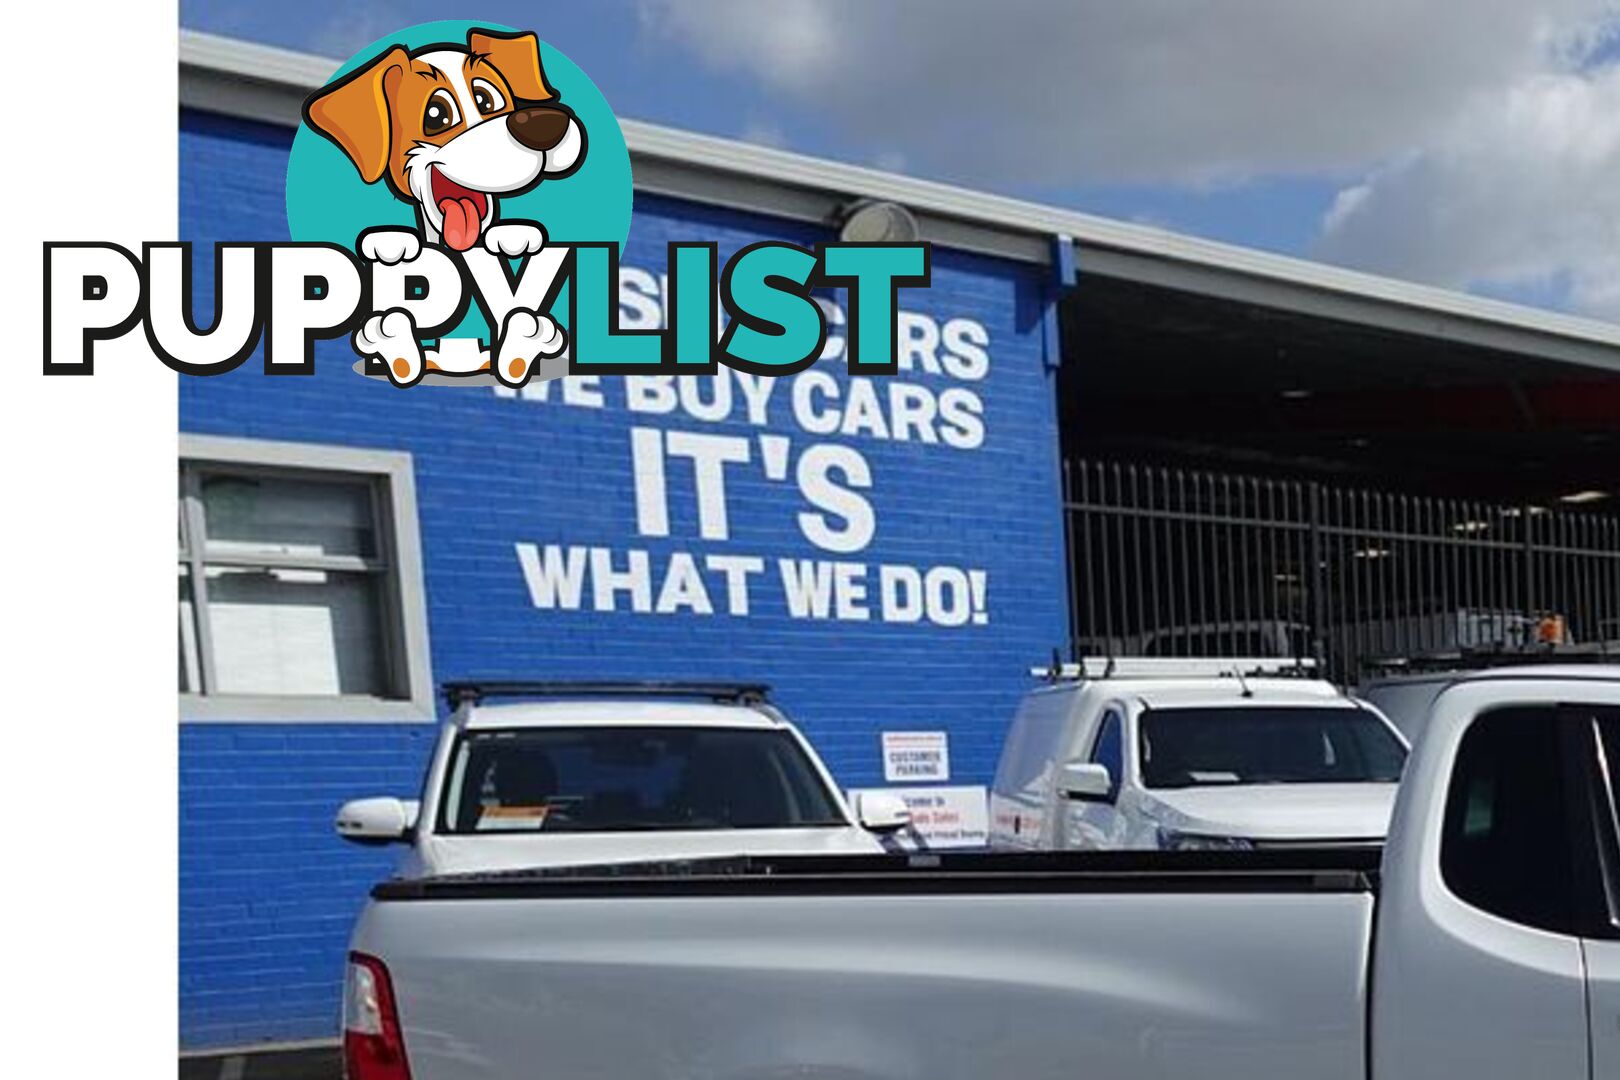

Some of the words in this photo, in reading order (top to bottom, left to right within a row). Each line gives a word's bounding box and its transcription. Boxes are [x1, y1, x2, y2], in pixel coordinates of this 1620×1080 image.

[792, 370, 987, 449] CARS
[631, 427, 876, 554] IT'S
[516, 543, 763, 615] WHAT
[779, 558, 869, 621] WE
[881, 565, 988, 627] DO!
